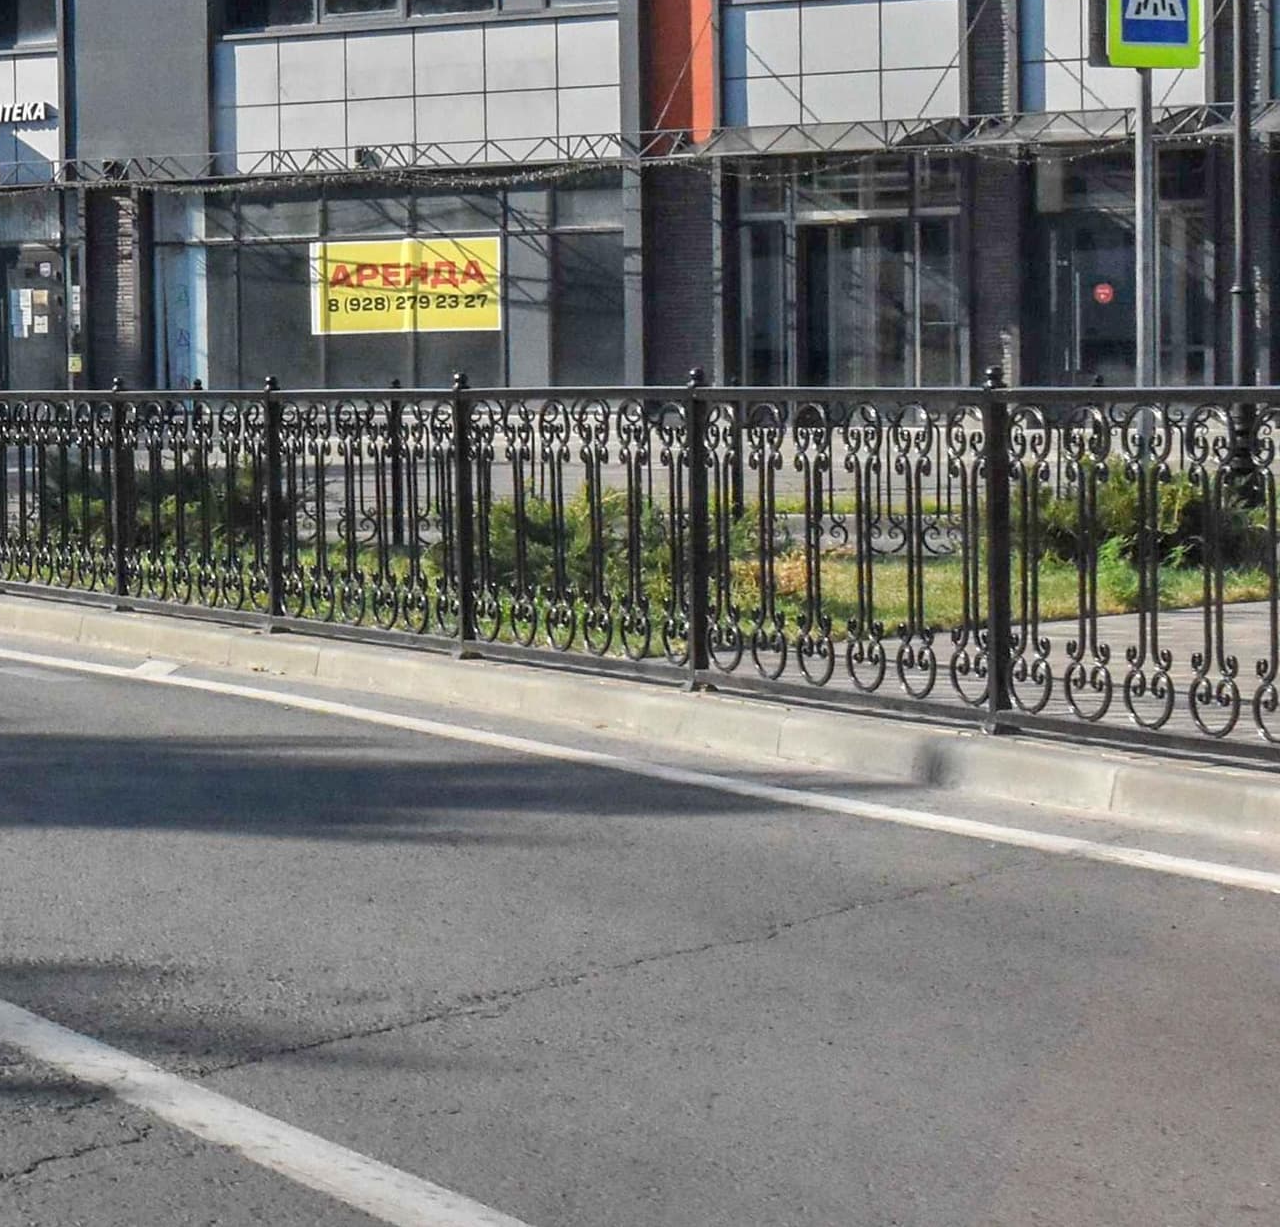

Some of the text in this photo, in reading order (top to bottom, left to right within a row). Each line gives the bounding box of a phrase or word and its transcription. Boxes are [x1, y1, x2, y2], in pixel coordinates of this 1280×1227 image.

[329, 260, 488, 289] АРЕНДА
[327, 293, 488, 314] 8 (928) 279 23 27
